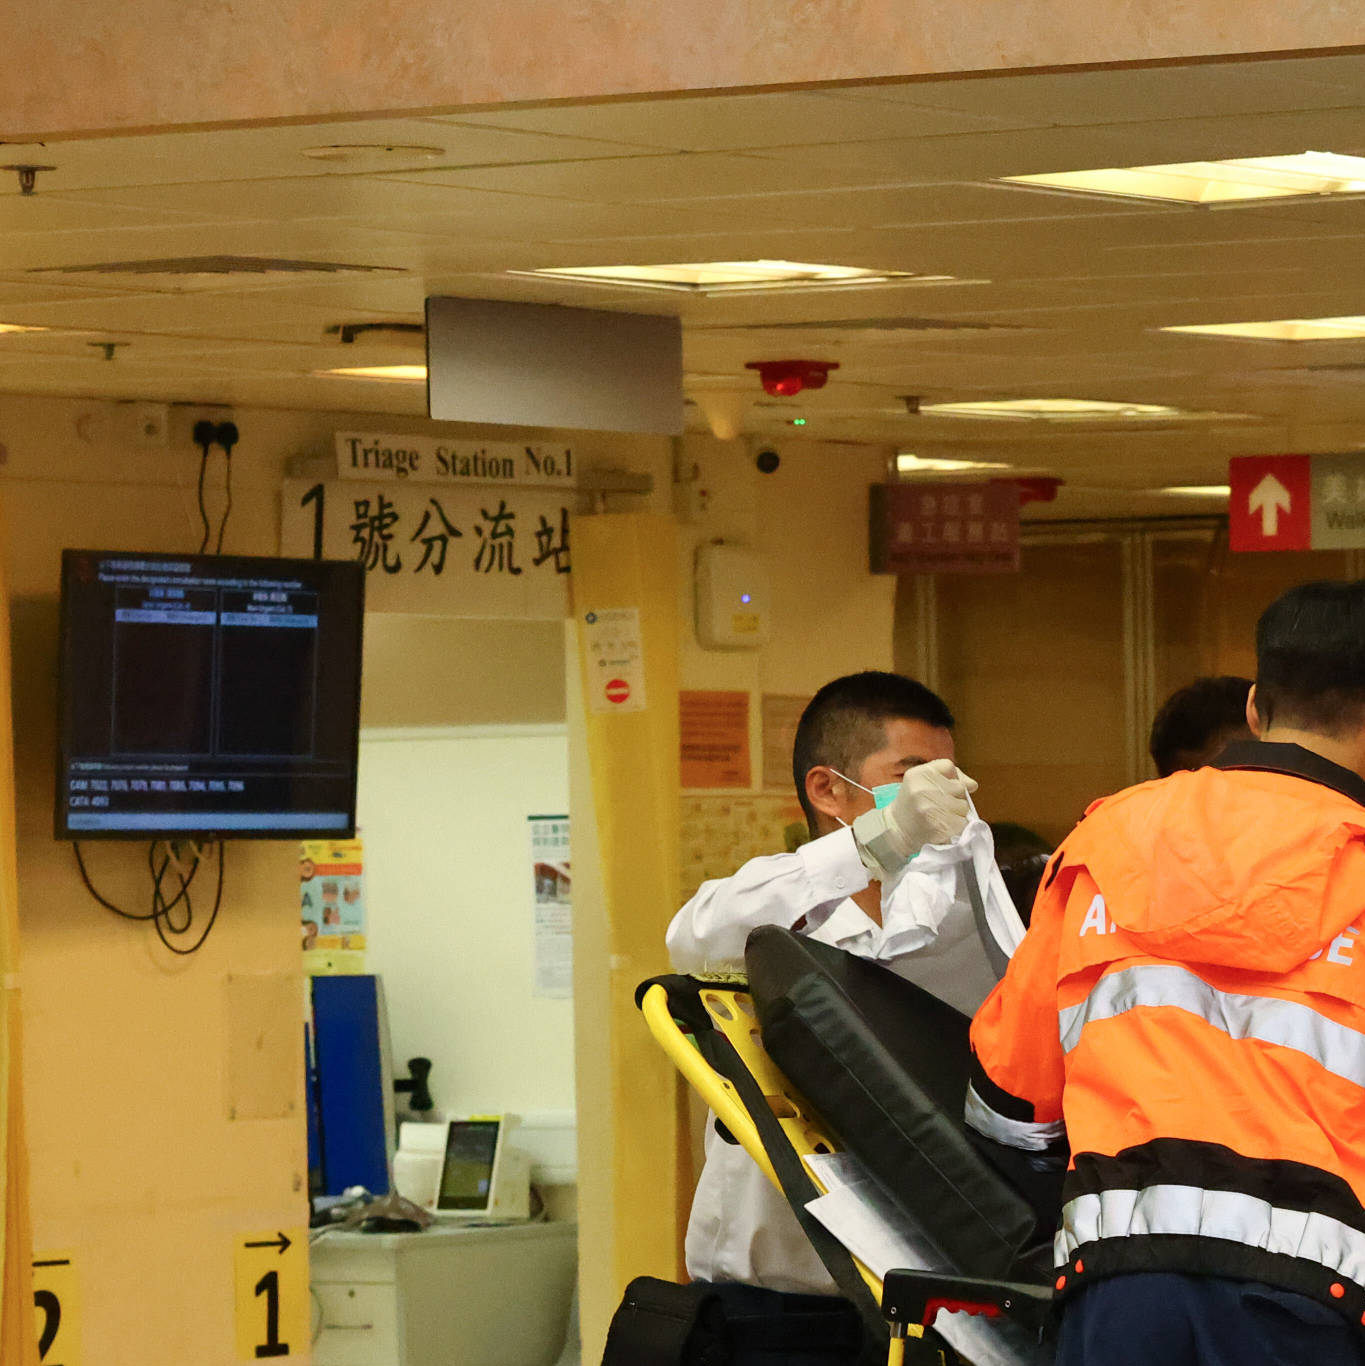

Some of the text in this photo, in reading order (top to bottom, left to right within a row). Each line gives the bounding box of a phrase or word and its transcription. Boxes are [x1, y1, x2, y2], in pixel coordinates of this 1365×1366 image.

[345, 438, 572, 478] Triage Station No.1
[255, 1271, 290, 1358] 1
